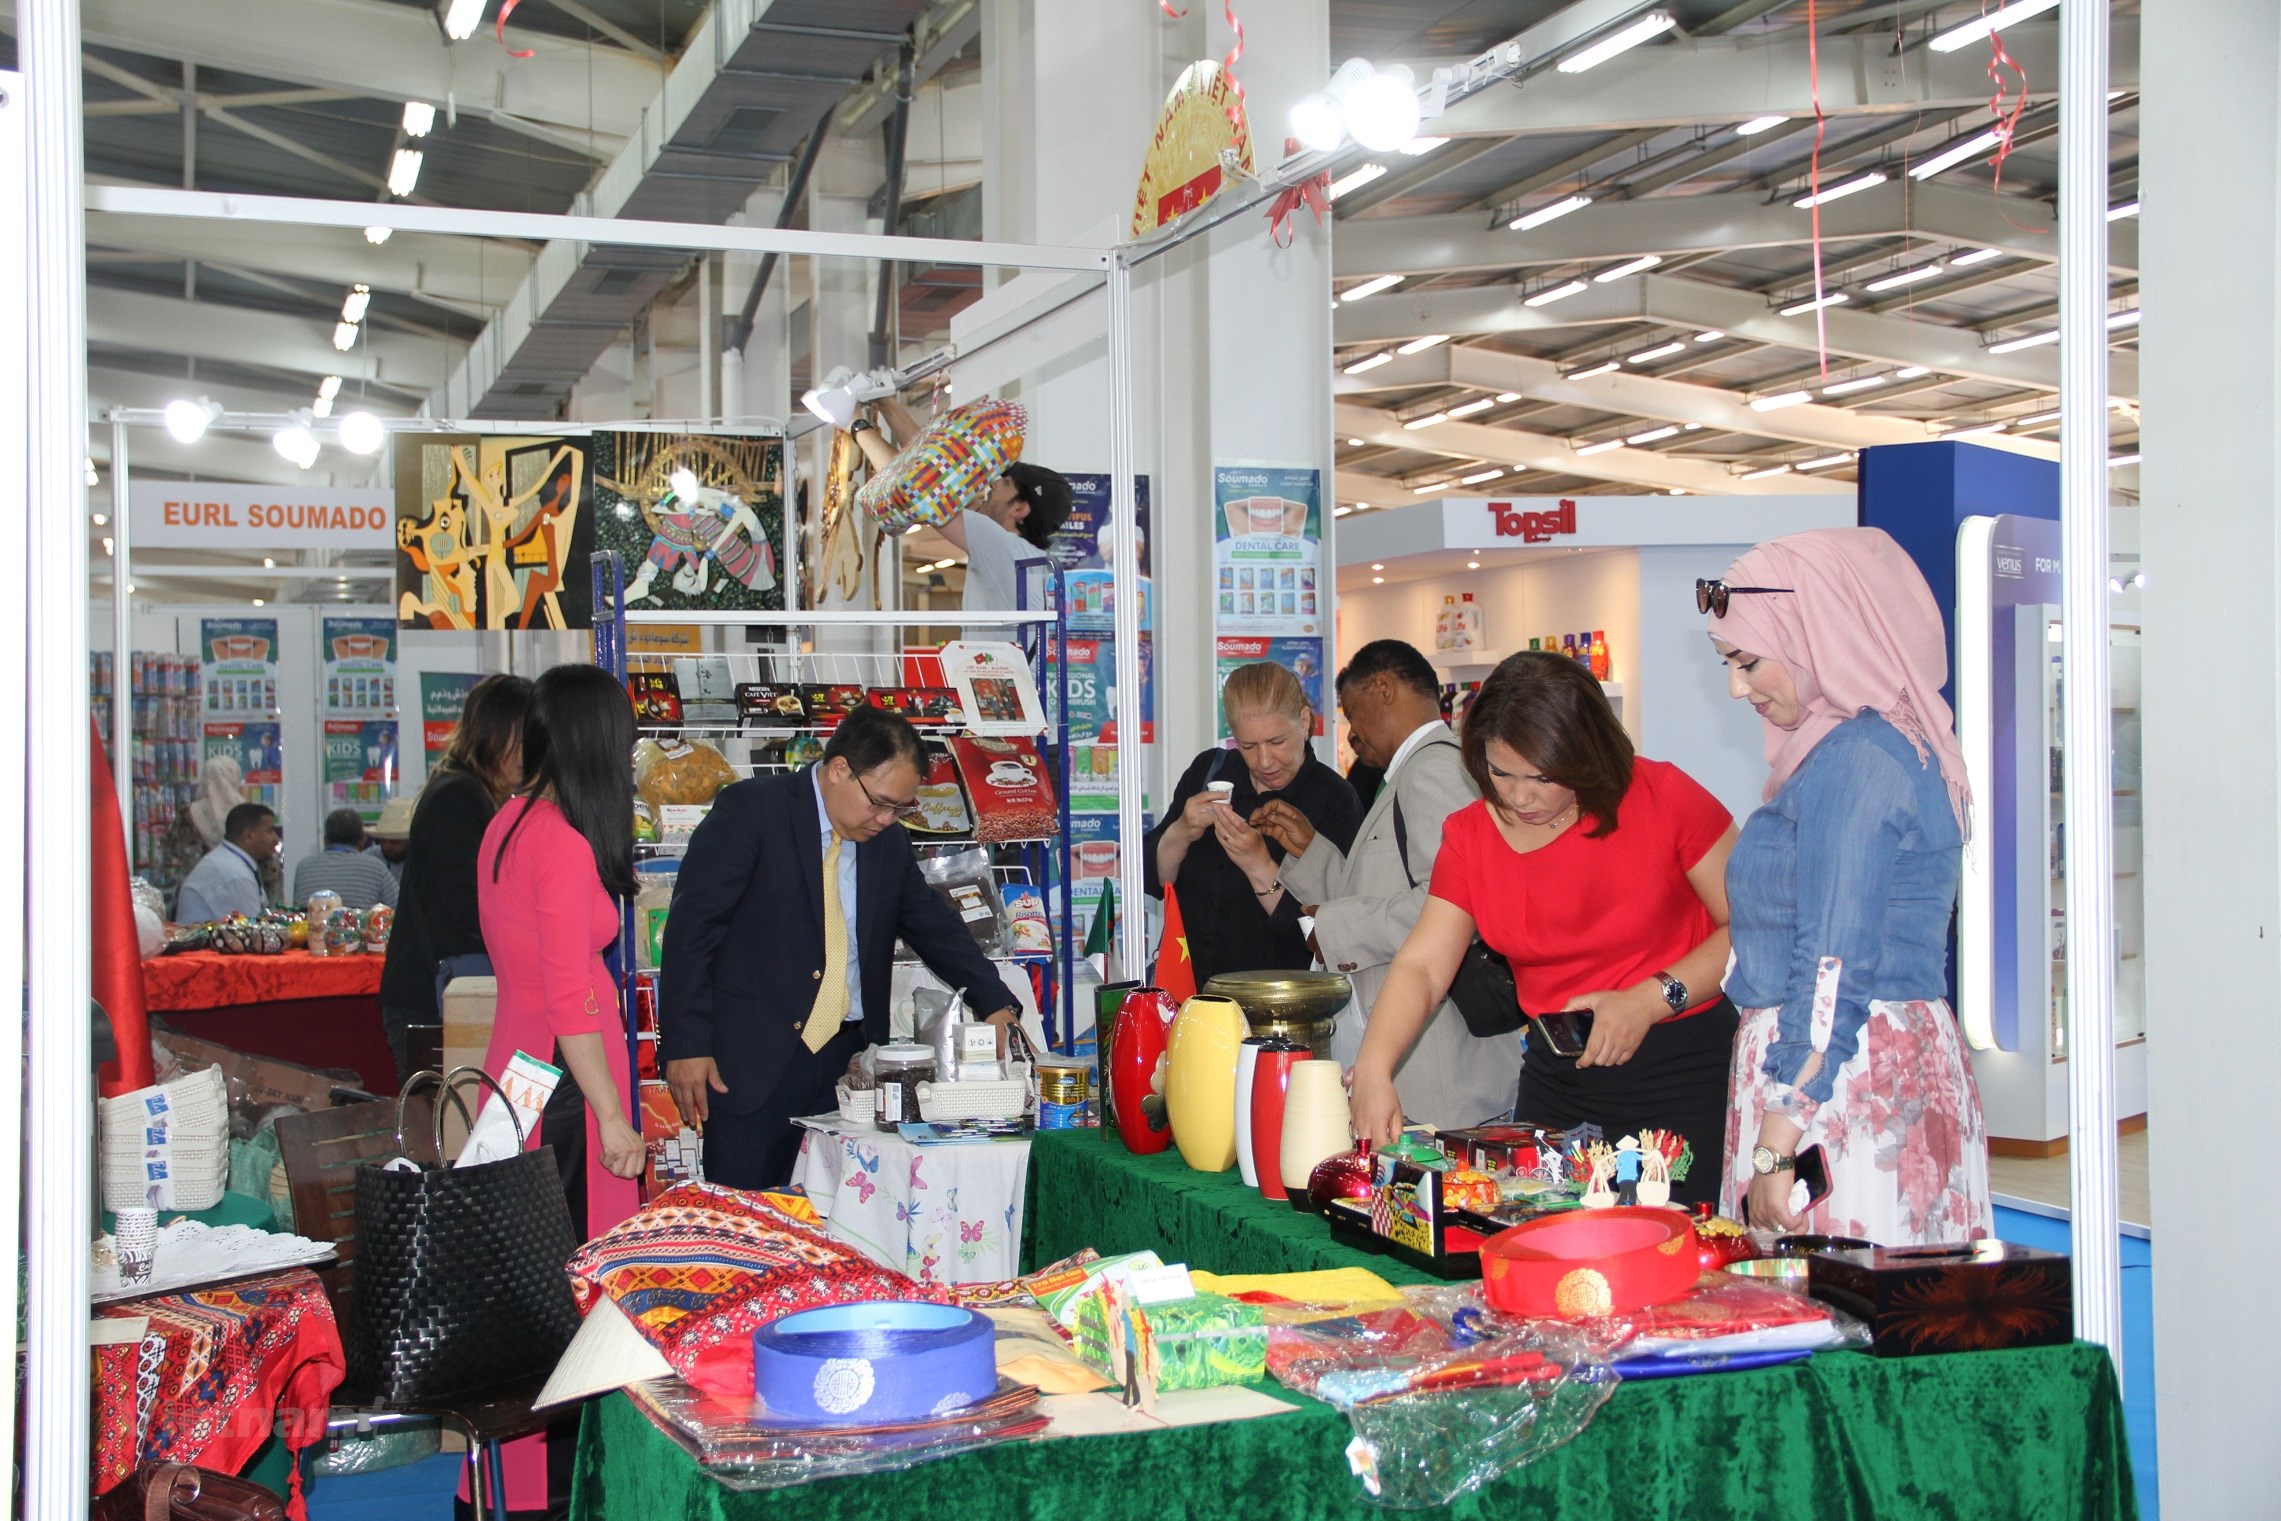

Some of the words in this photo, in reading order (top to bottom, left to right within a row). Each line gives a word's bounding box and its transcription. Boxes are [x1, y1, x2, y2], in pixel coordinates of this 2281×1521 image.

[1217, 472, 1268, 484] Soumado
[163, 501, 239, 527] EURL
[247, 503, 387, 531] SOUMADO
[1487, 498, 1576, 543] Topsil
[1235, 541, 1273, 550] DENTAL
[1274, 541, 1300, 551] CARE
[2034, 557, 2052, 573] FOR
[1217, 641, 1262, 651] Soumado
[1046, 679, 1097, 699] KDS
[994, 788, 1016, 796] Ground
